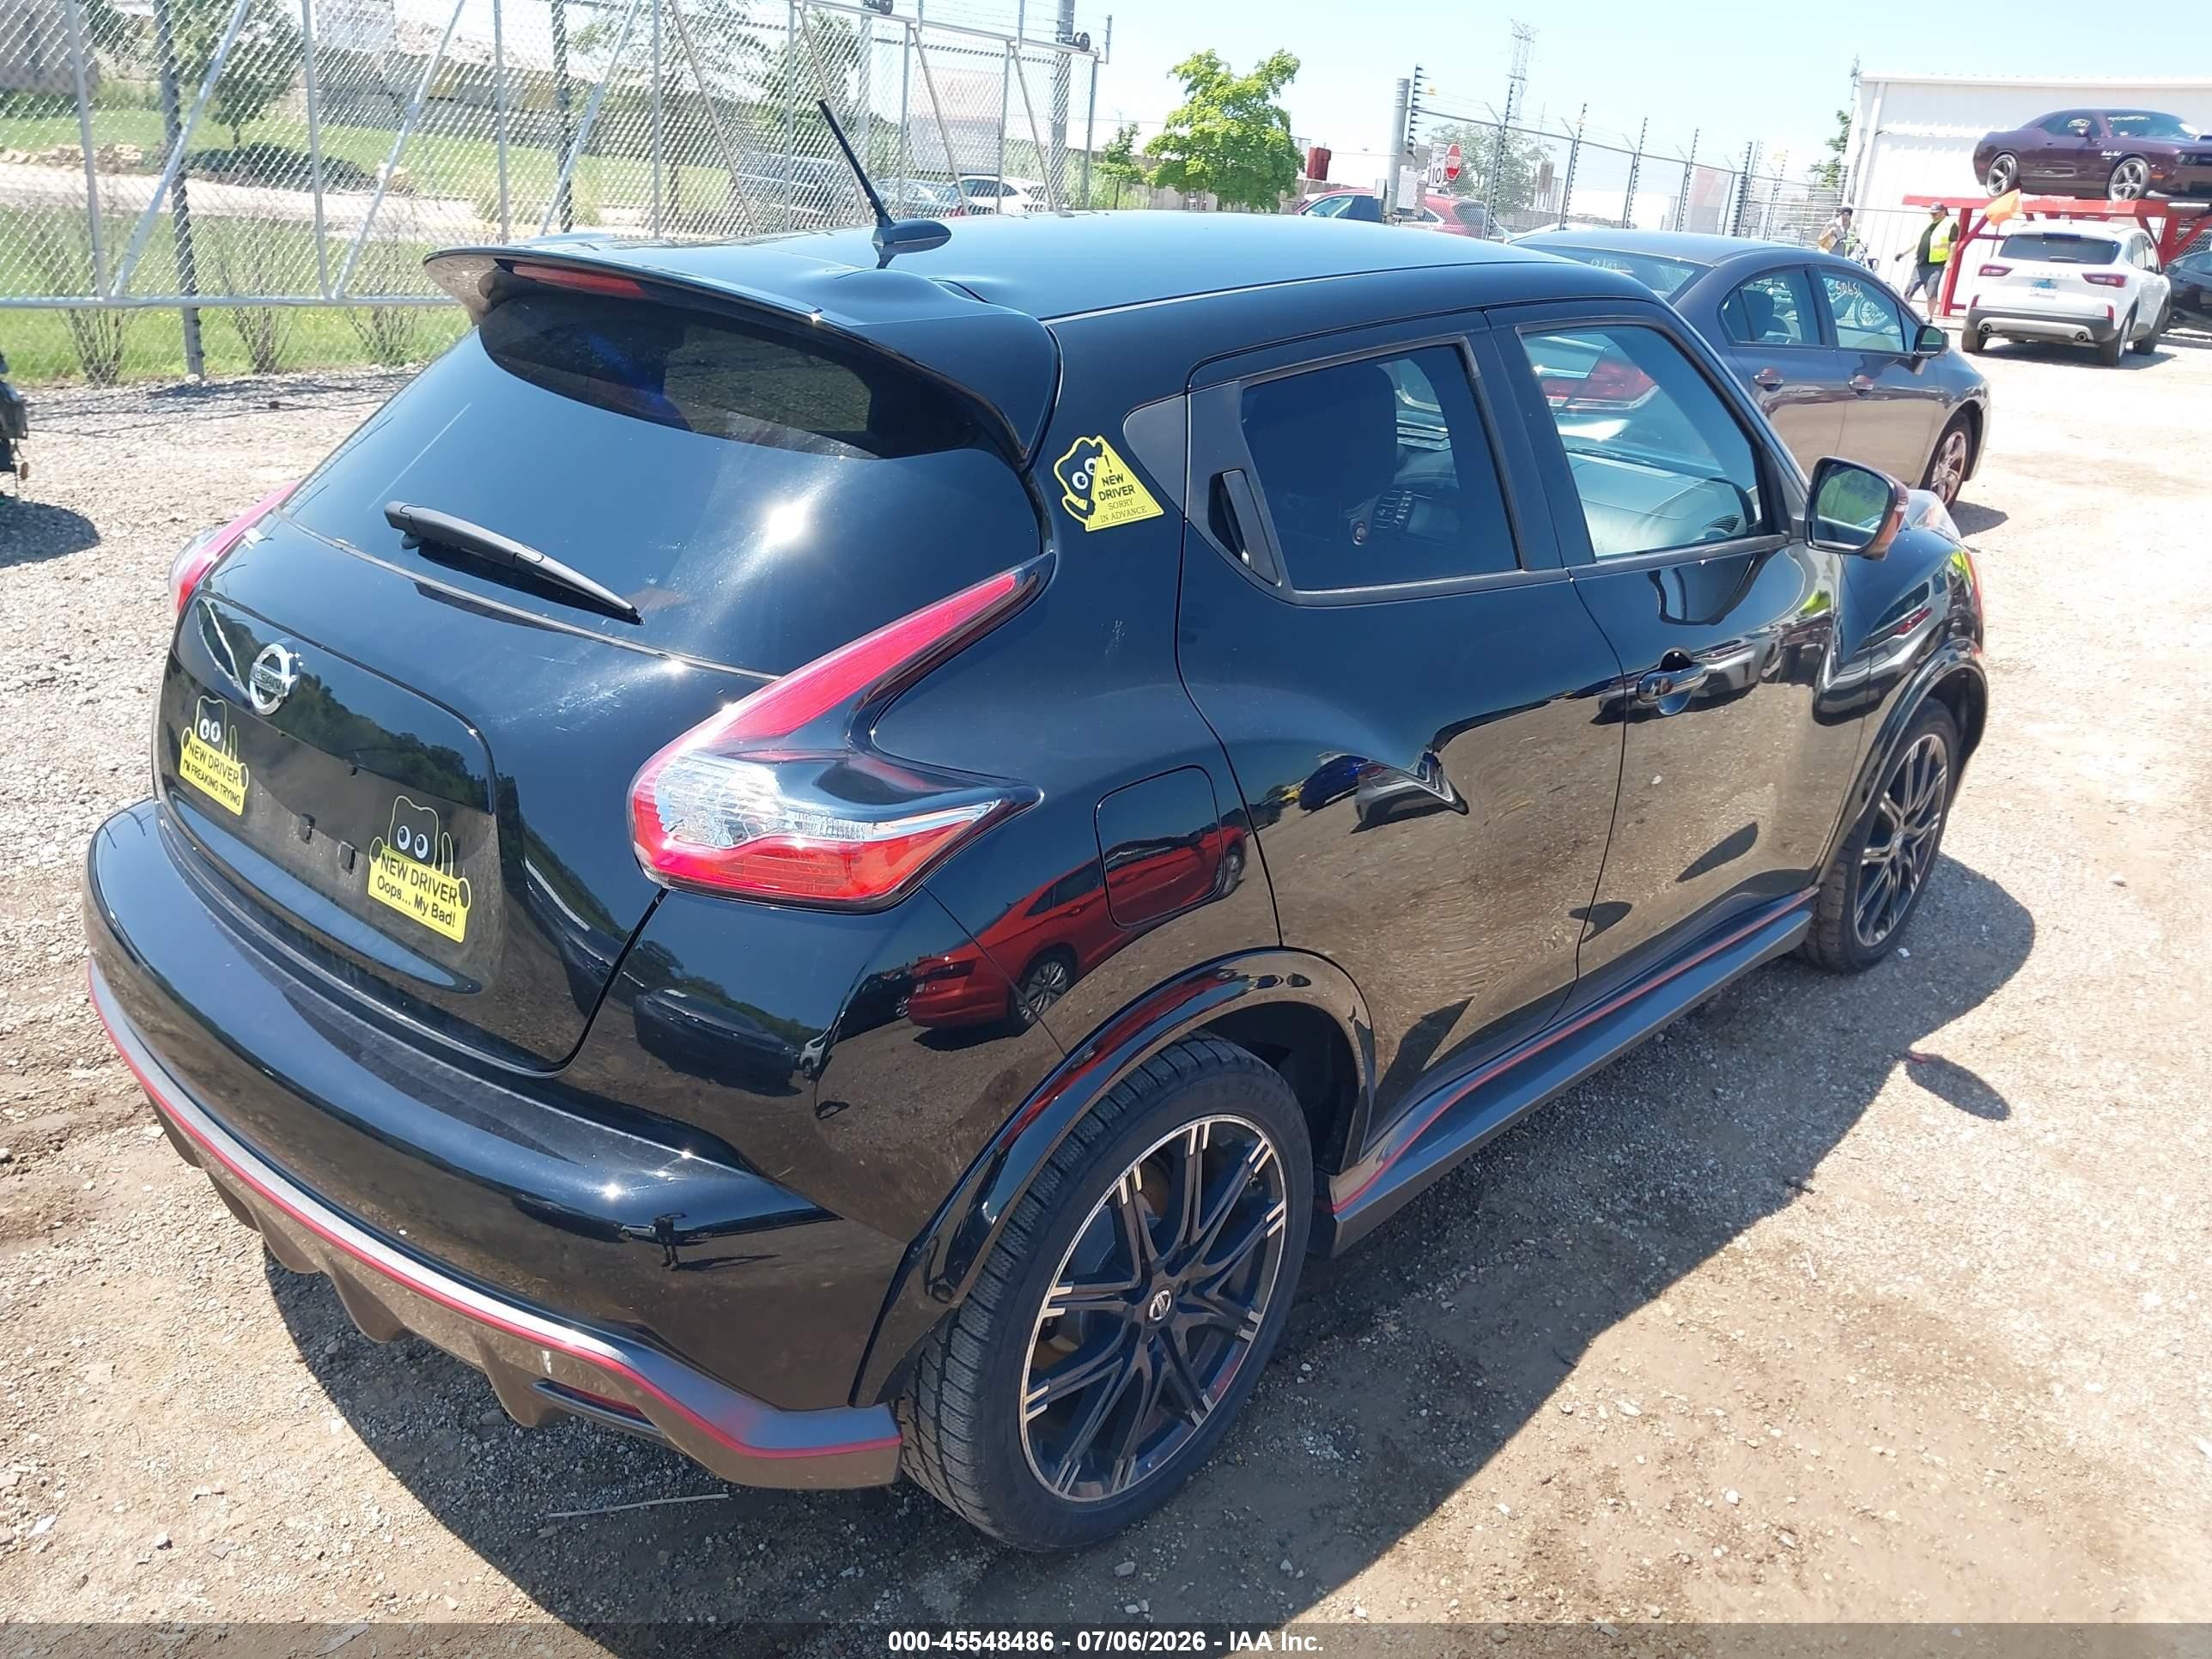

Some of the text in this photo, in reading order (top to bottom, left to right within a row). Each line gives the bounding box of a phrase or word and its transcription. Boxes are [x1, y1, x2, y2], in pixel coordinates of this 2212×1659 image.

[1432, 166, 1442, 184] 10
[1102, 473, 1124, 486] NEW
[1098, 484, 1135, 501] DRIVER
[1107, 498, 1133, 510] SORRY
[1111, 505, 1147, 520] ADVANCE
[189, 741, 240, 787] NEW DRIVER
[191, 764, 219, 791] FREAKING
[220, 783, 241, 806] TRYING
[380, 853, 458, 908] NEW DRIVER
[378, 875, 456, 928] Oops... My Bad!
